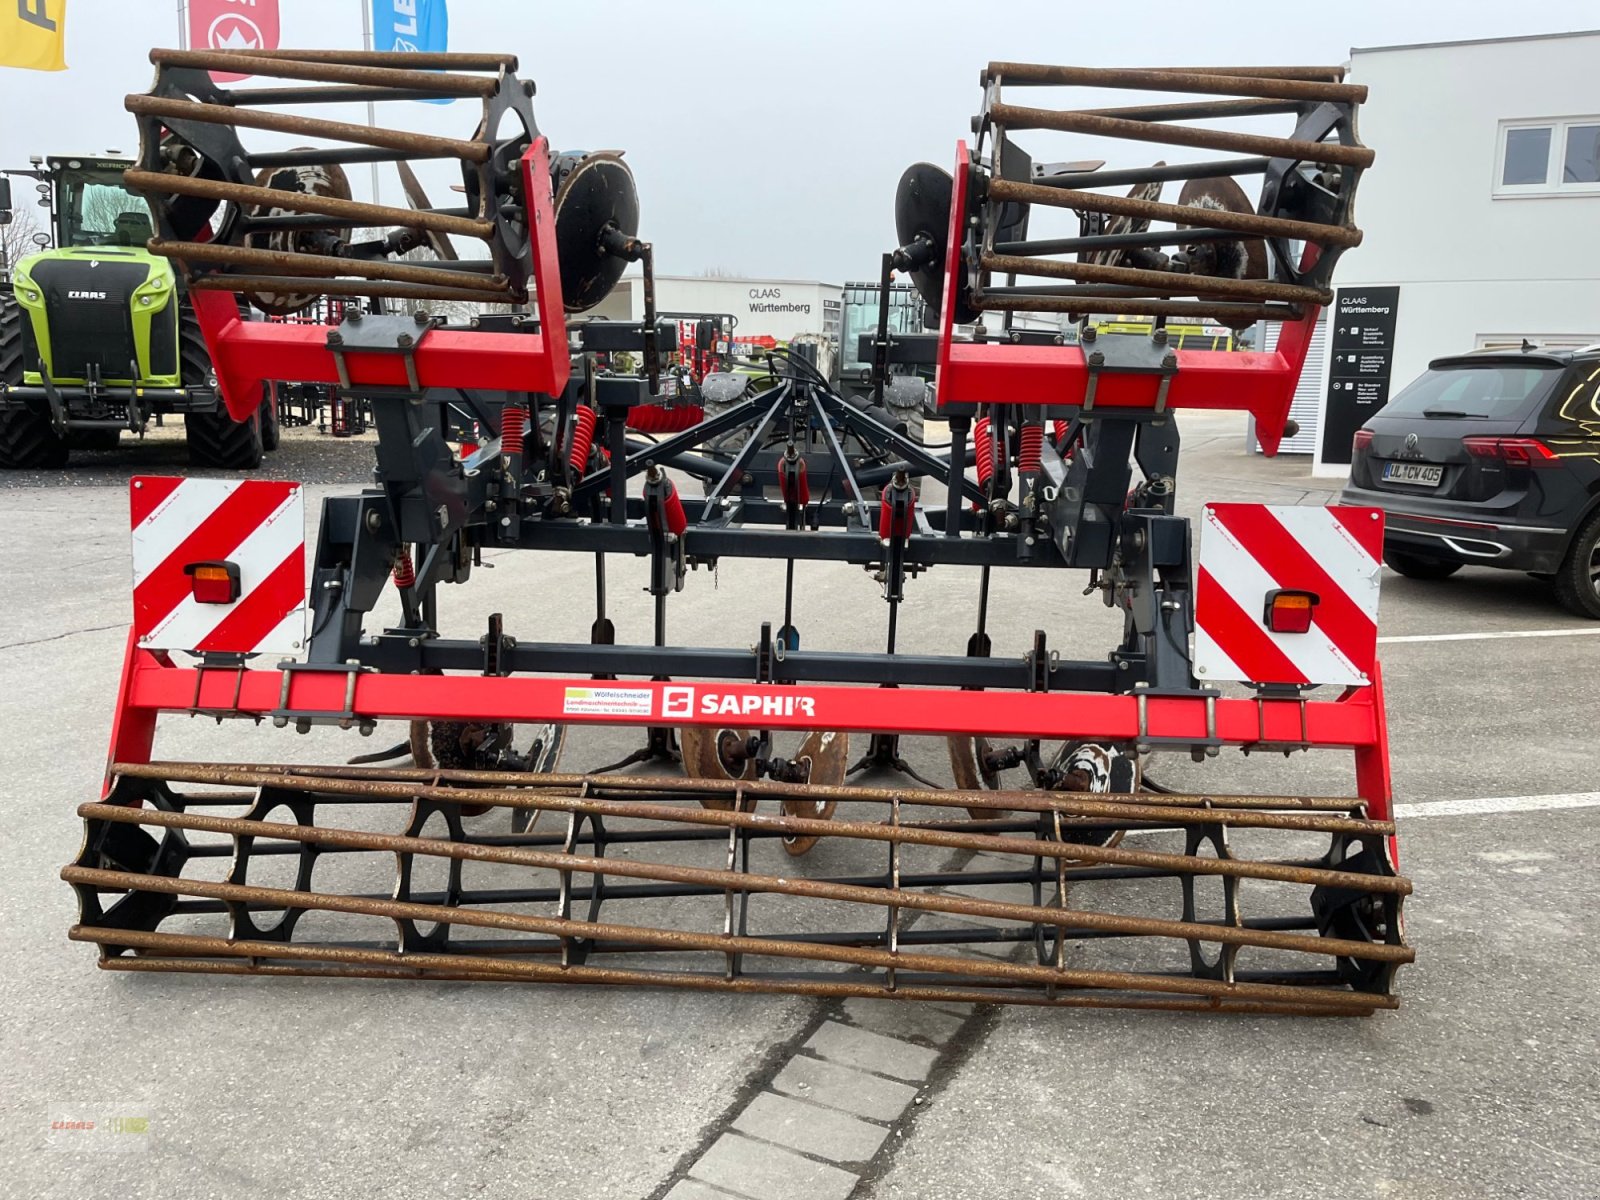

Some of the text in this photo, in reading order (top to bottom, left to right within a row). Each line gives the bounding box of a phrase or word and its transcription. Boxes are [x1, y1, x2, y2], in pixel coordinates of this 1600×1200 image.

[68, 290, 107, 300] CLAAS
[749, 288, 781, 299] CLAAS
[1341, 297, 1368, 305] CLAAS
[749, 302, 811, 315] Württemberg
[1340, 306, 1390, 315] Württemberg
[1390, 464, 1402, 478] UL
[1421, 467, 1442, 482] 405
[700, 693, 815, 717] SAPHIR
